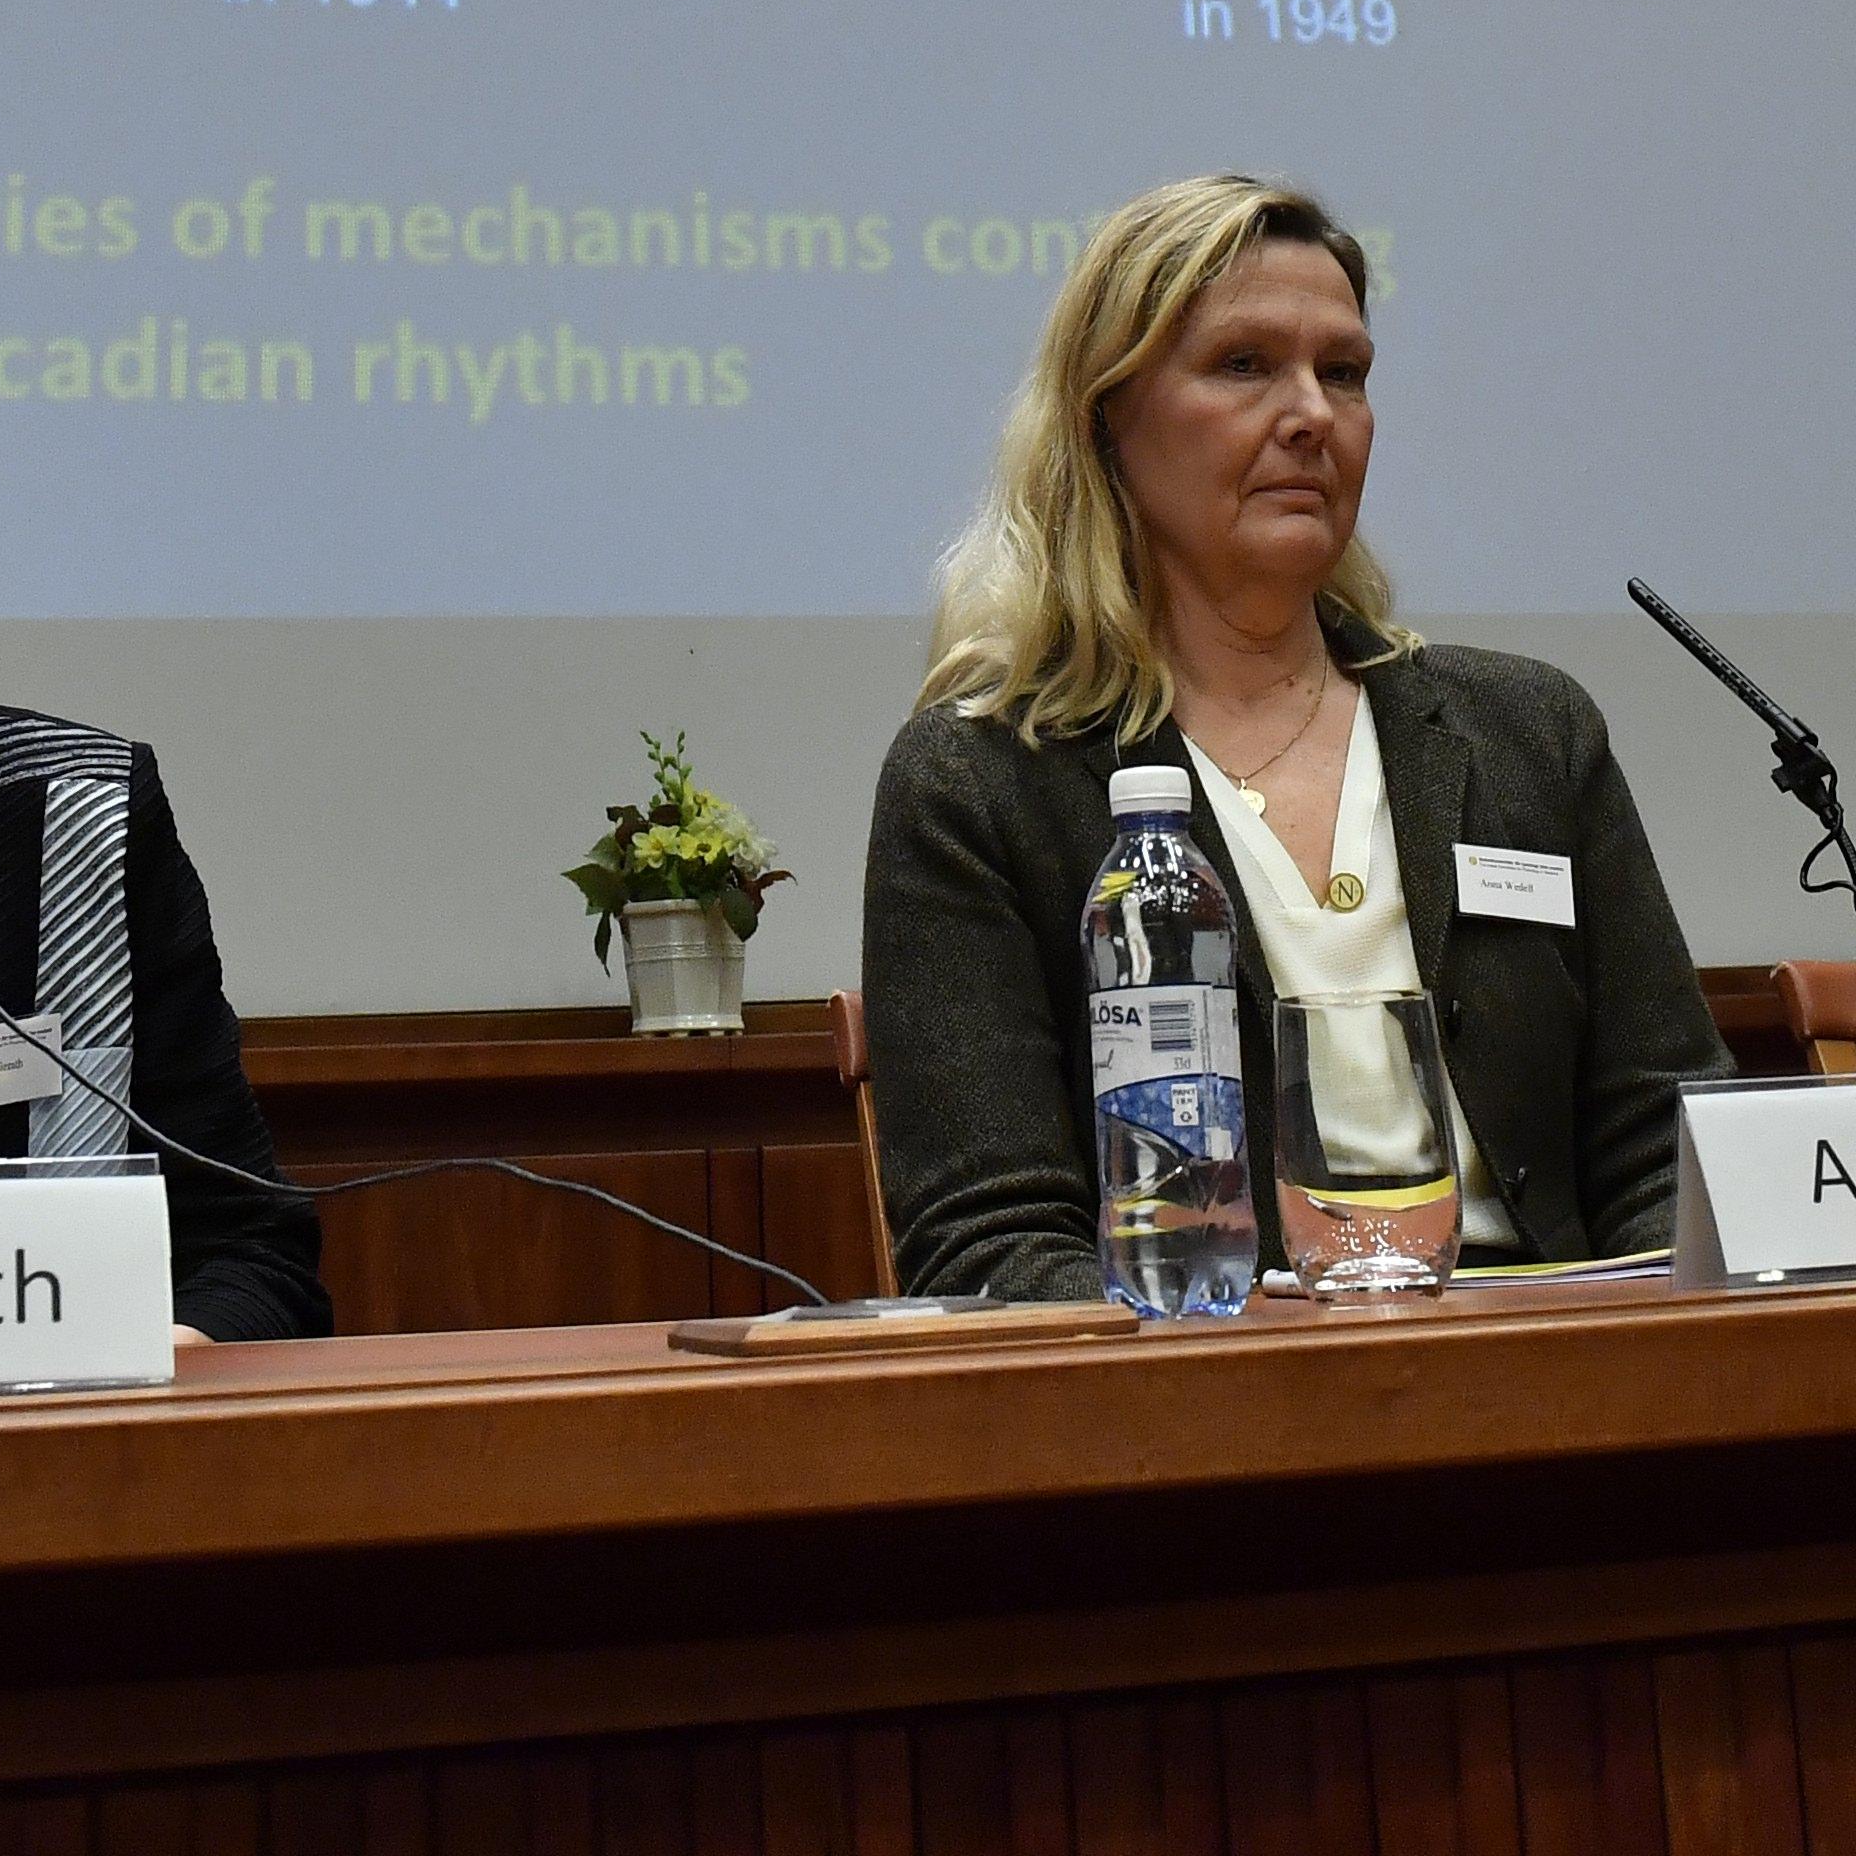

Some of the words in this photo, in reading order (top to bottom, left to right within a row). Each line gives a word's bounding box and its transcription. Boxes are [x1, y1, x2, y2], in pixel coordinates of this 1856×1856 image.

[173, 176, 274, 260] of
[305, 184, 894, 274] mechanisms
[352, 323, 753, 425] rhythms
